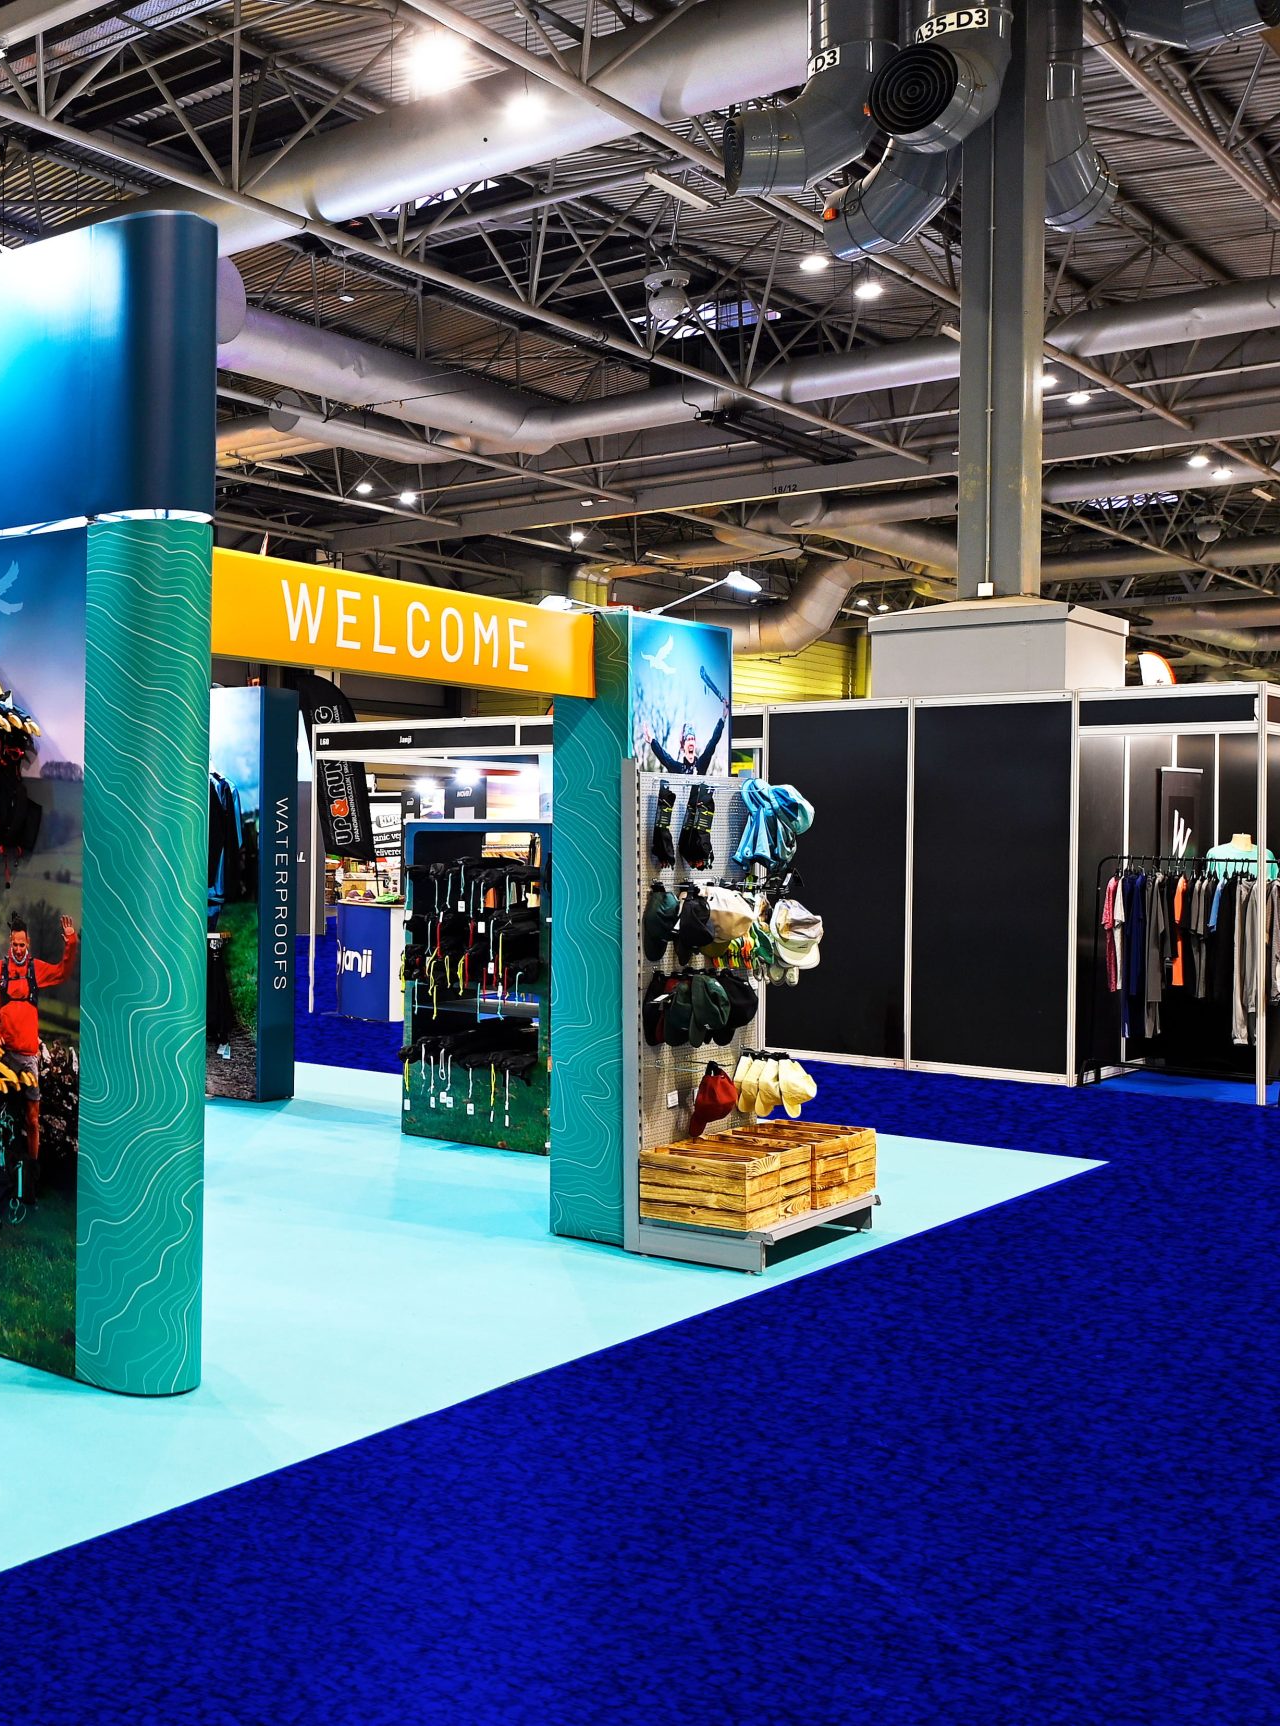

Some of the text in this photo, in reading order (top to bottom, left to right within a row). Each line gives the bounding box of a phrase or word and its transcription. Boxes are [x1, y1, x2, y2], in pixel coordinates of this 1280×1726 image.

[281, 579, 529, 672] WELCOME
[273, 797, 290, 990] WATERPROOFS
[341, 946, 373, 979] janji
